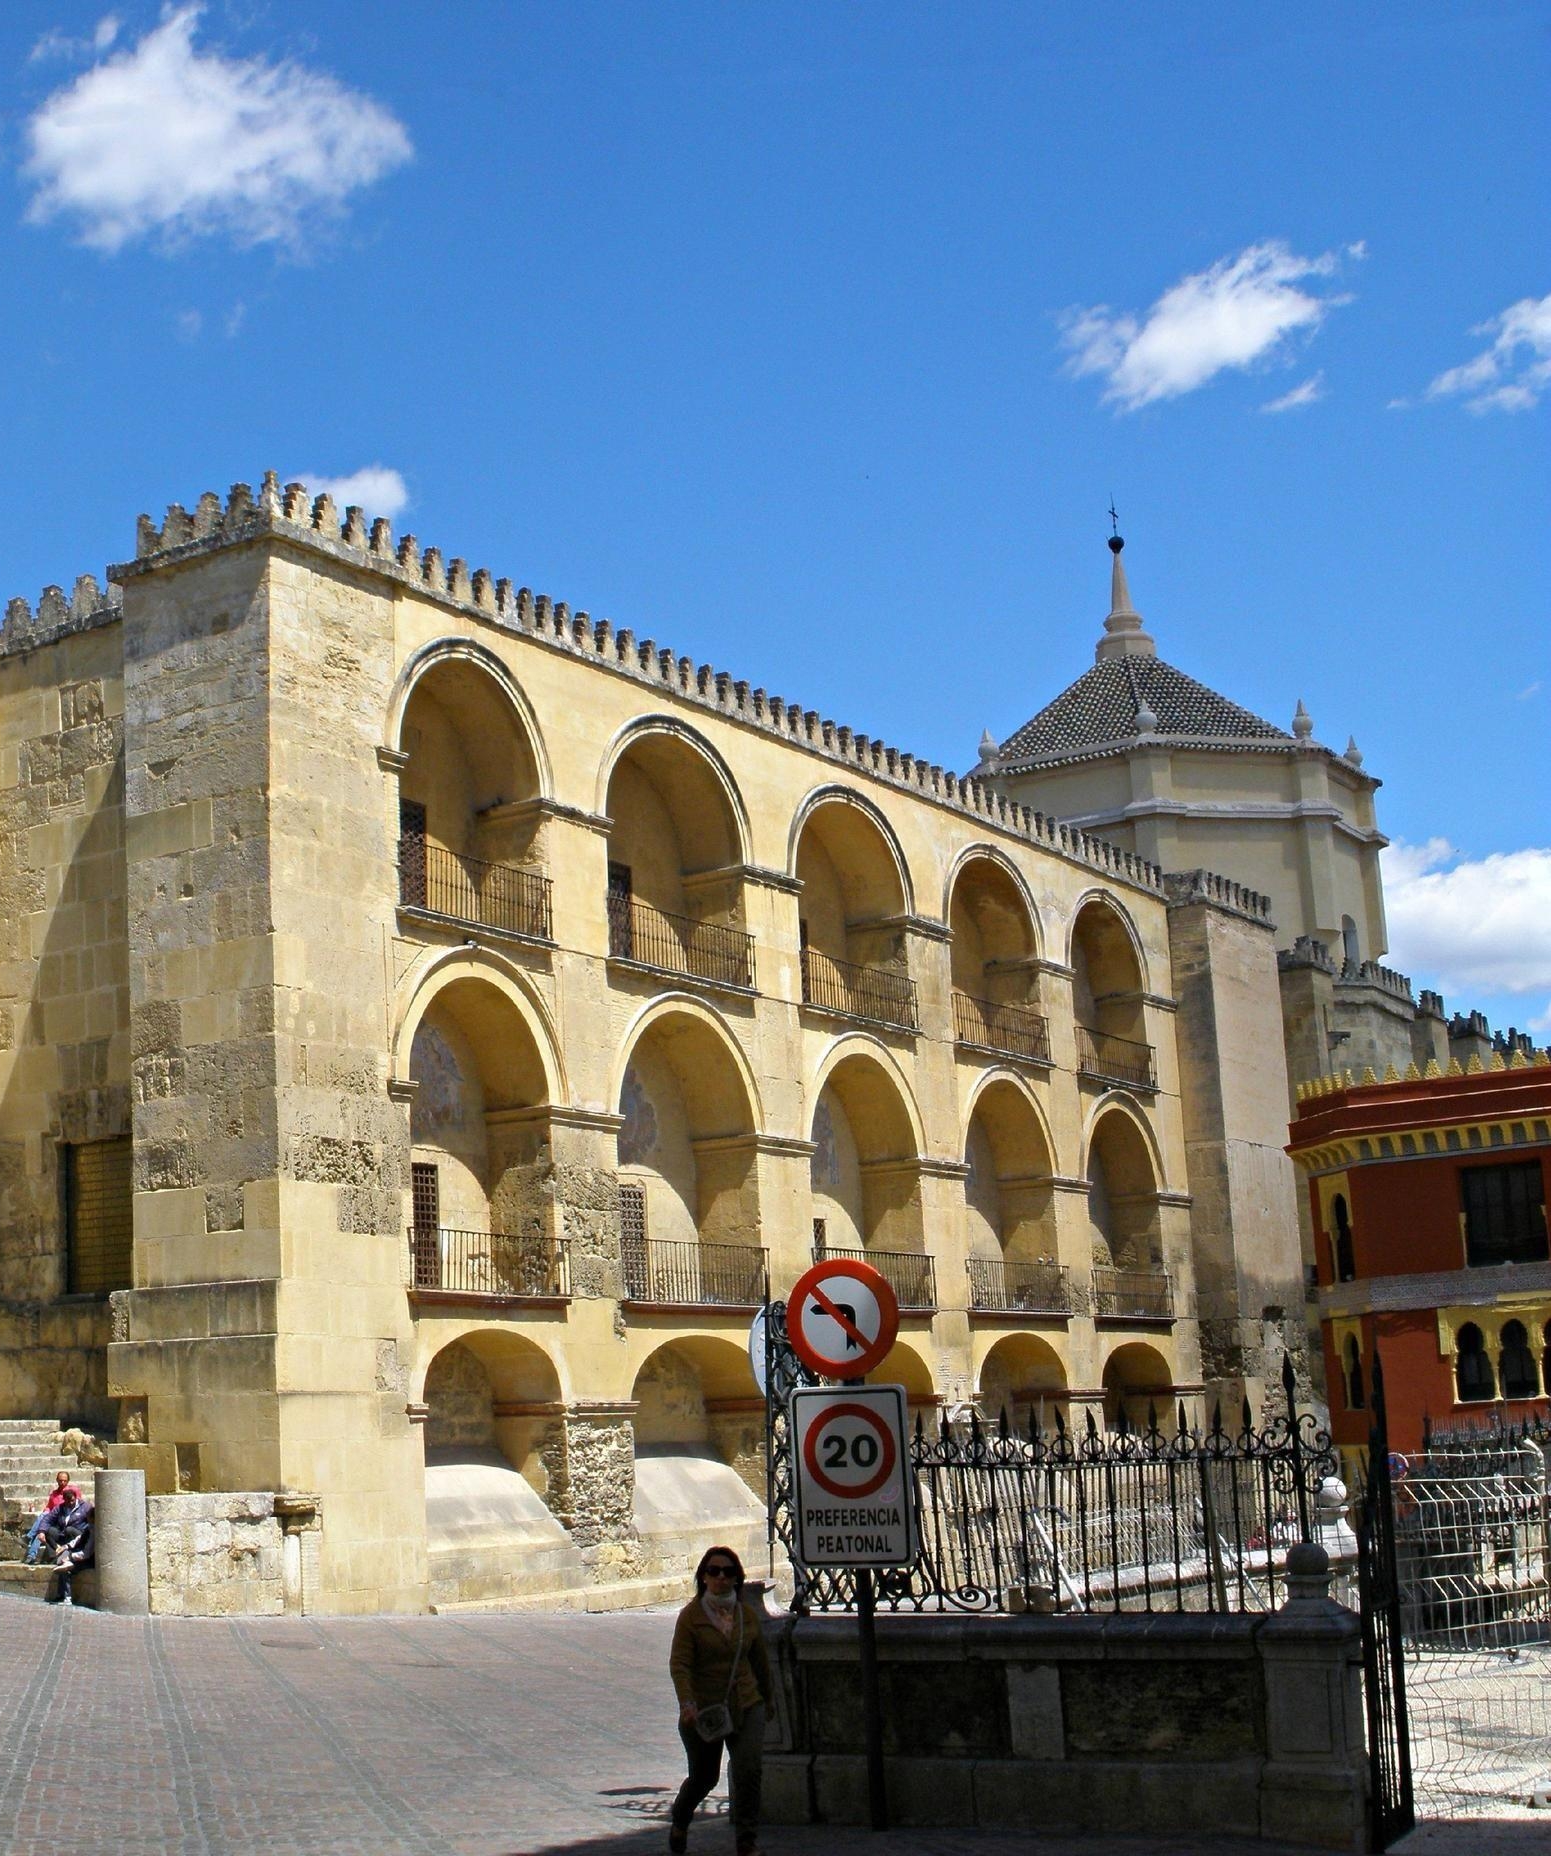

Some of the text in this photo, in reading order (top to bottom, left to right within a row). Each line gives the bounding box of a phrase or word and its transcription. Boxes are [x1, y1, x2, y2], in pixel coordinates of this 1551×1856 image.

[823, 1434, 878, 1468] 20
[807, 1508, 901, 1527] PREFERENCIA
[817, 1535, 892, 1553] PEATONAL
